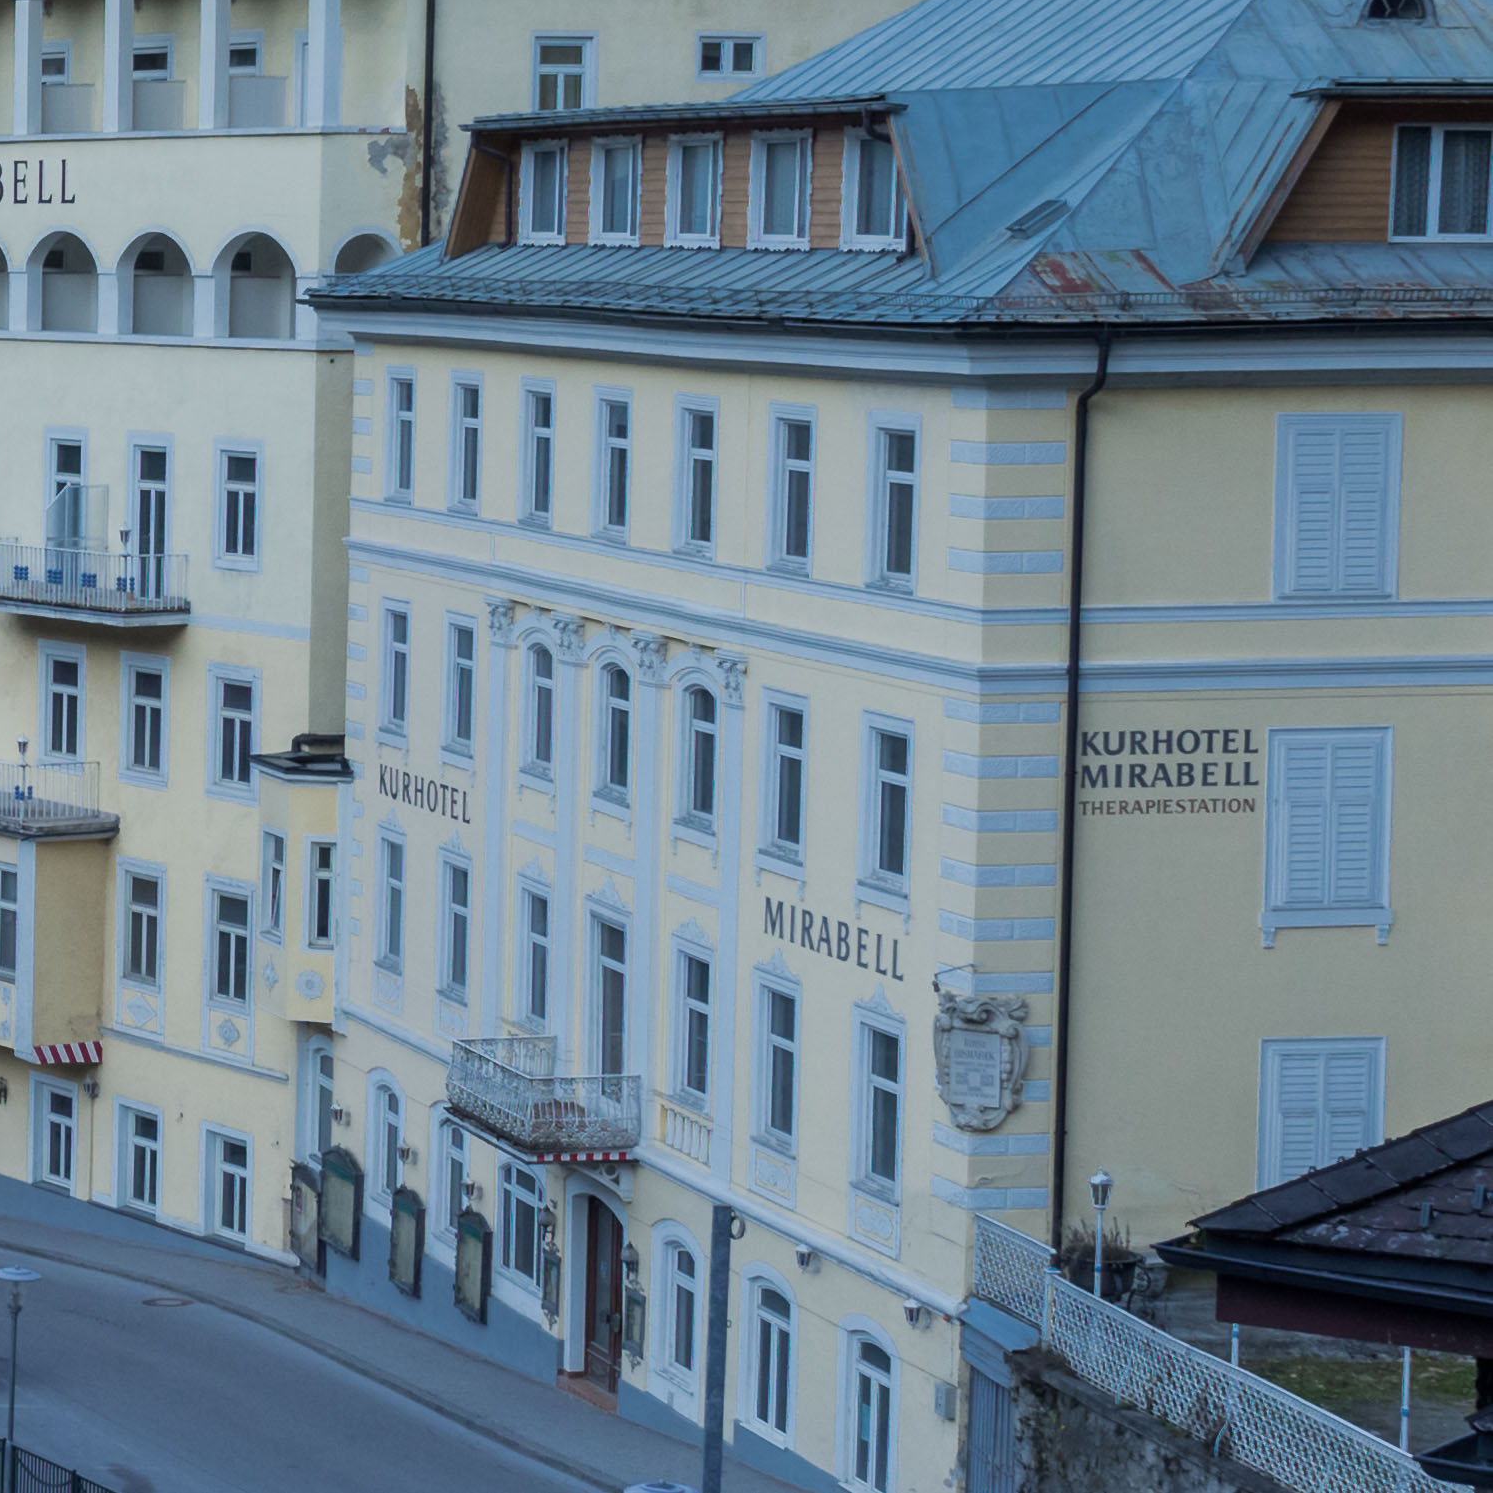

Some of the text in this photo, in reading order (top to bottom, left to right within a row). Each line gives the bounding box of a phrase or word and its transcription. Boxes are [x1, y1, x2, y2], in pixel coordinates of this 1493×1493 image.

[1081, 727, 1259, 757] KURHOTEL
[1080, 760, 1260, 789] MIRABELL
[378, 763, 472, 824] KURHOTEL
[1078, 797, 1256, 816] THERAPIESTATION
[763, 896, 905, 983] MIRABELL
